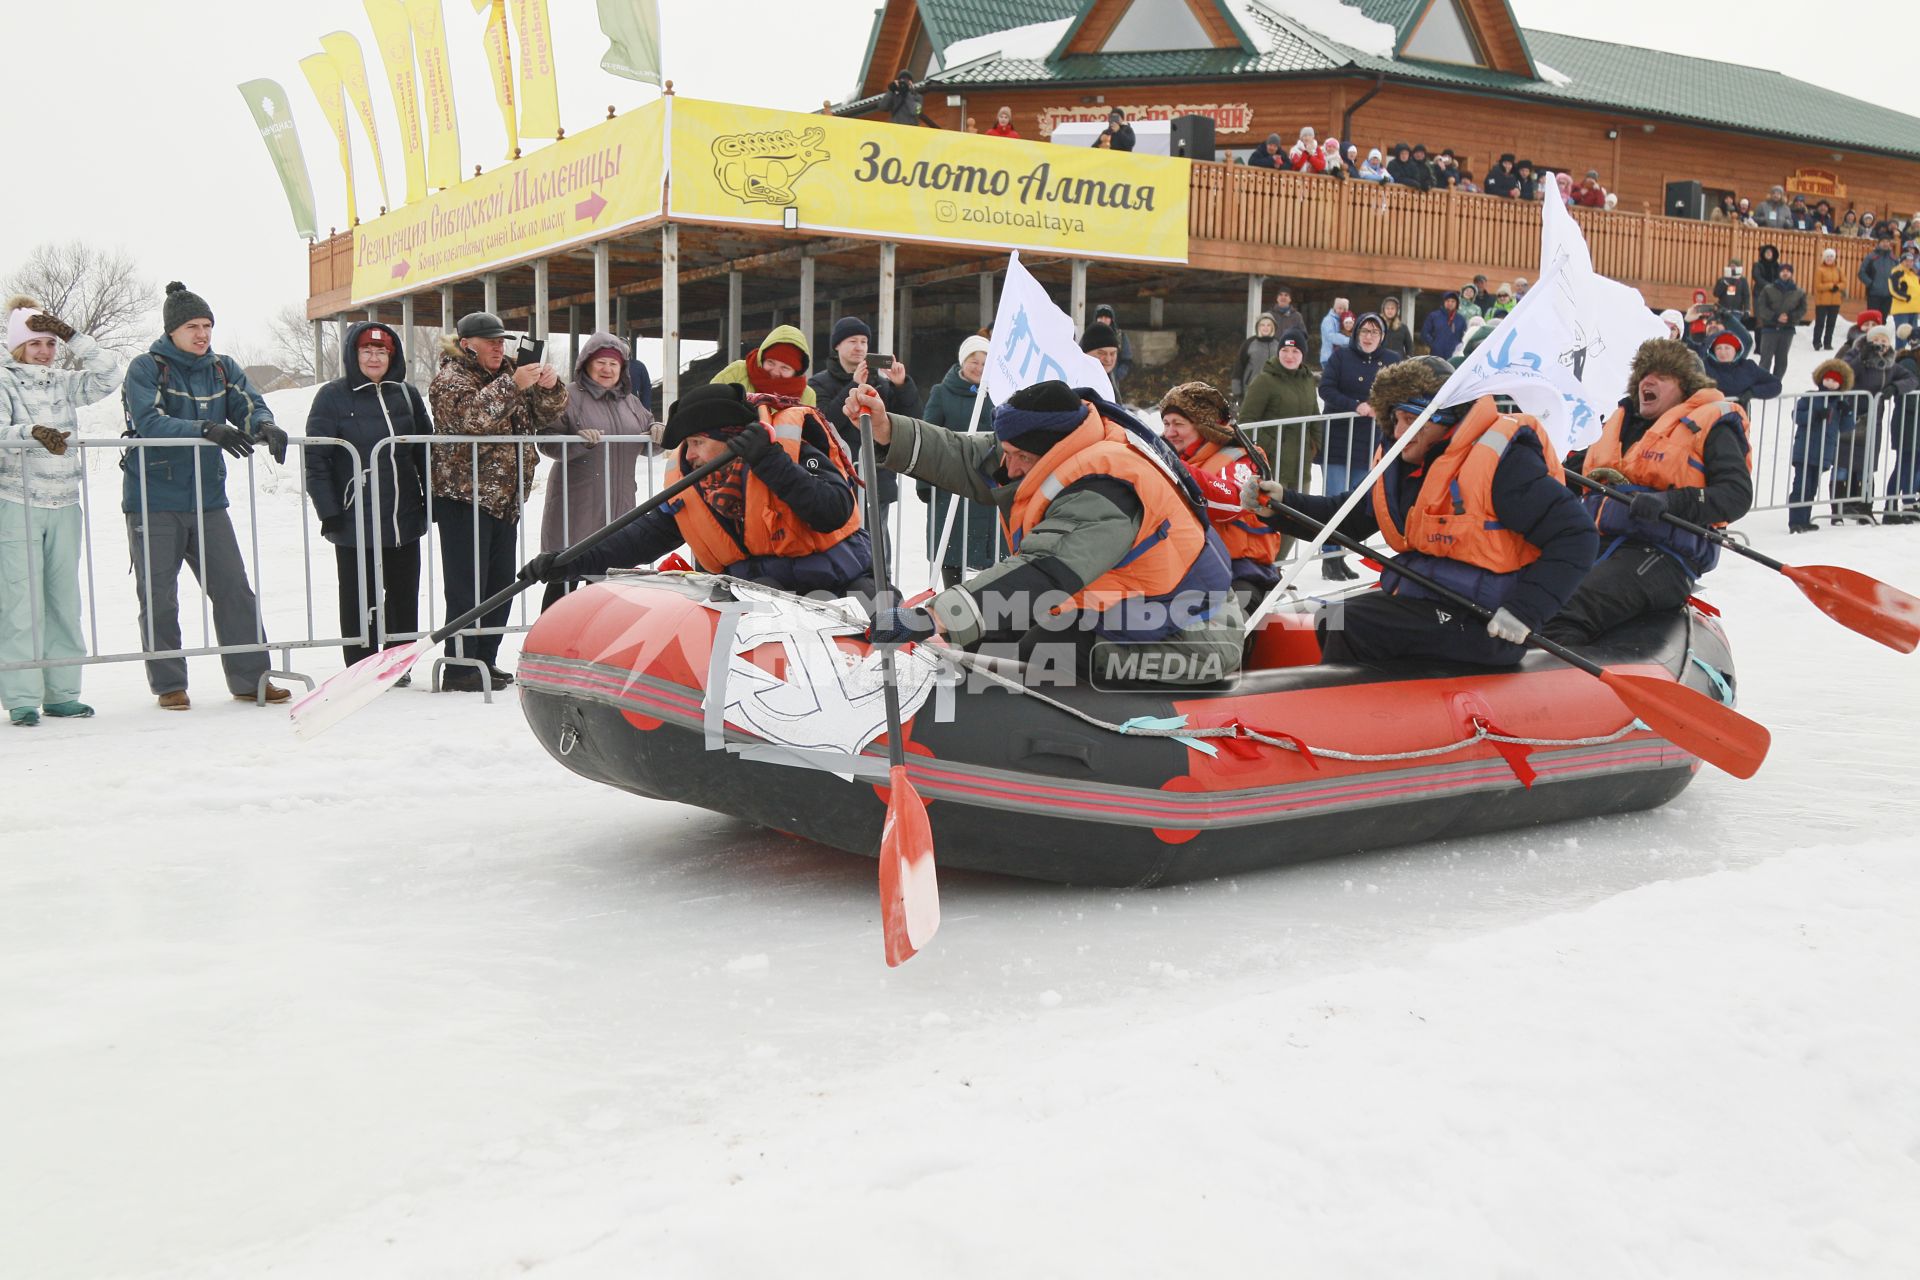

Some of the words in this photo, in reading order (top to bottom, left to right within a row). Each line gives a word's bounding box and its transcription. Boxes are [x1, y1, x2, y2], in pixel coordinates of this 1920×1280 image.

[854, 141, 1010, 197] Золото
[1017, 162, 1156, 212] Алтая
[358, 219, 427, 268] Резиденция
[431, 184, 504, 242] Сибирской
[508, 144, 622, 215] Масленицы
[961, 205, 1085, 235] zolotoaltaya
[509, 220, 527, 243] Как
[528, 221, 538, 237] по
